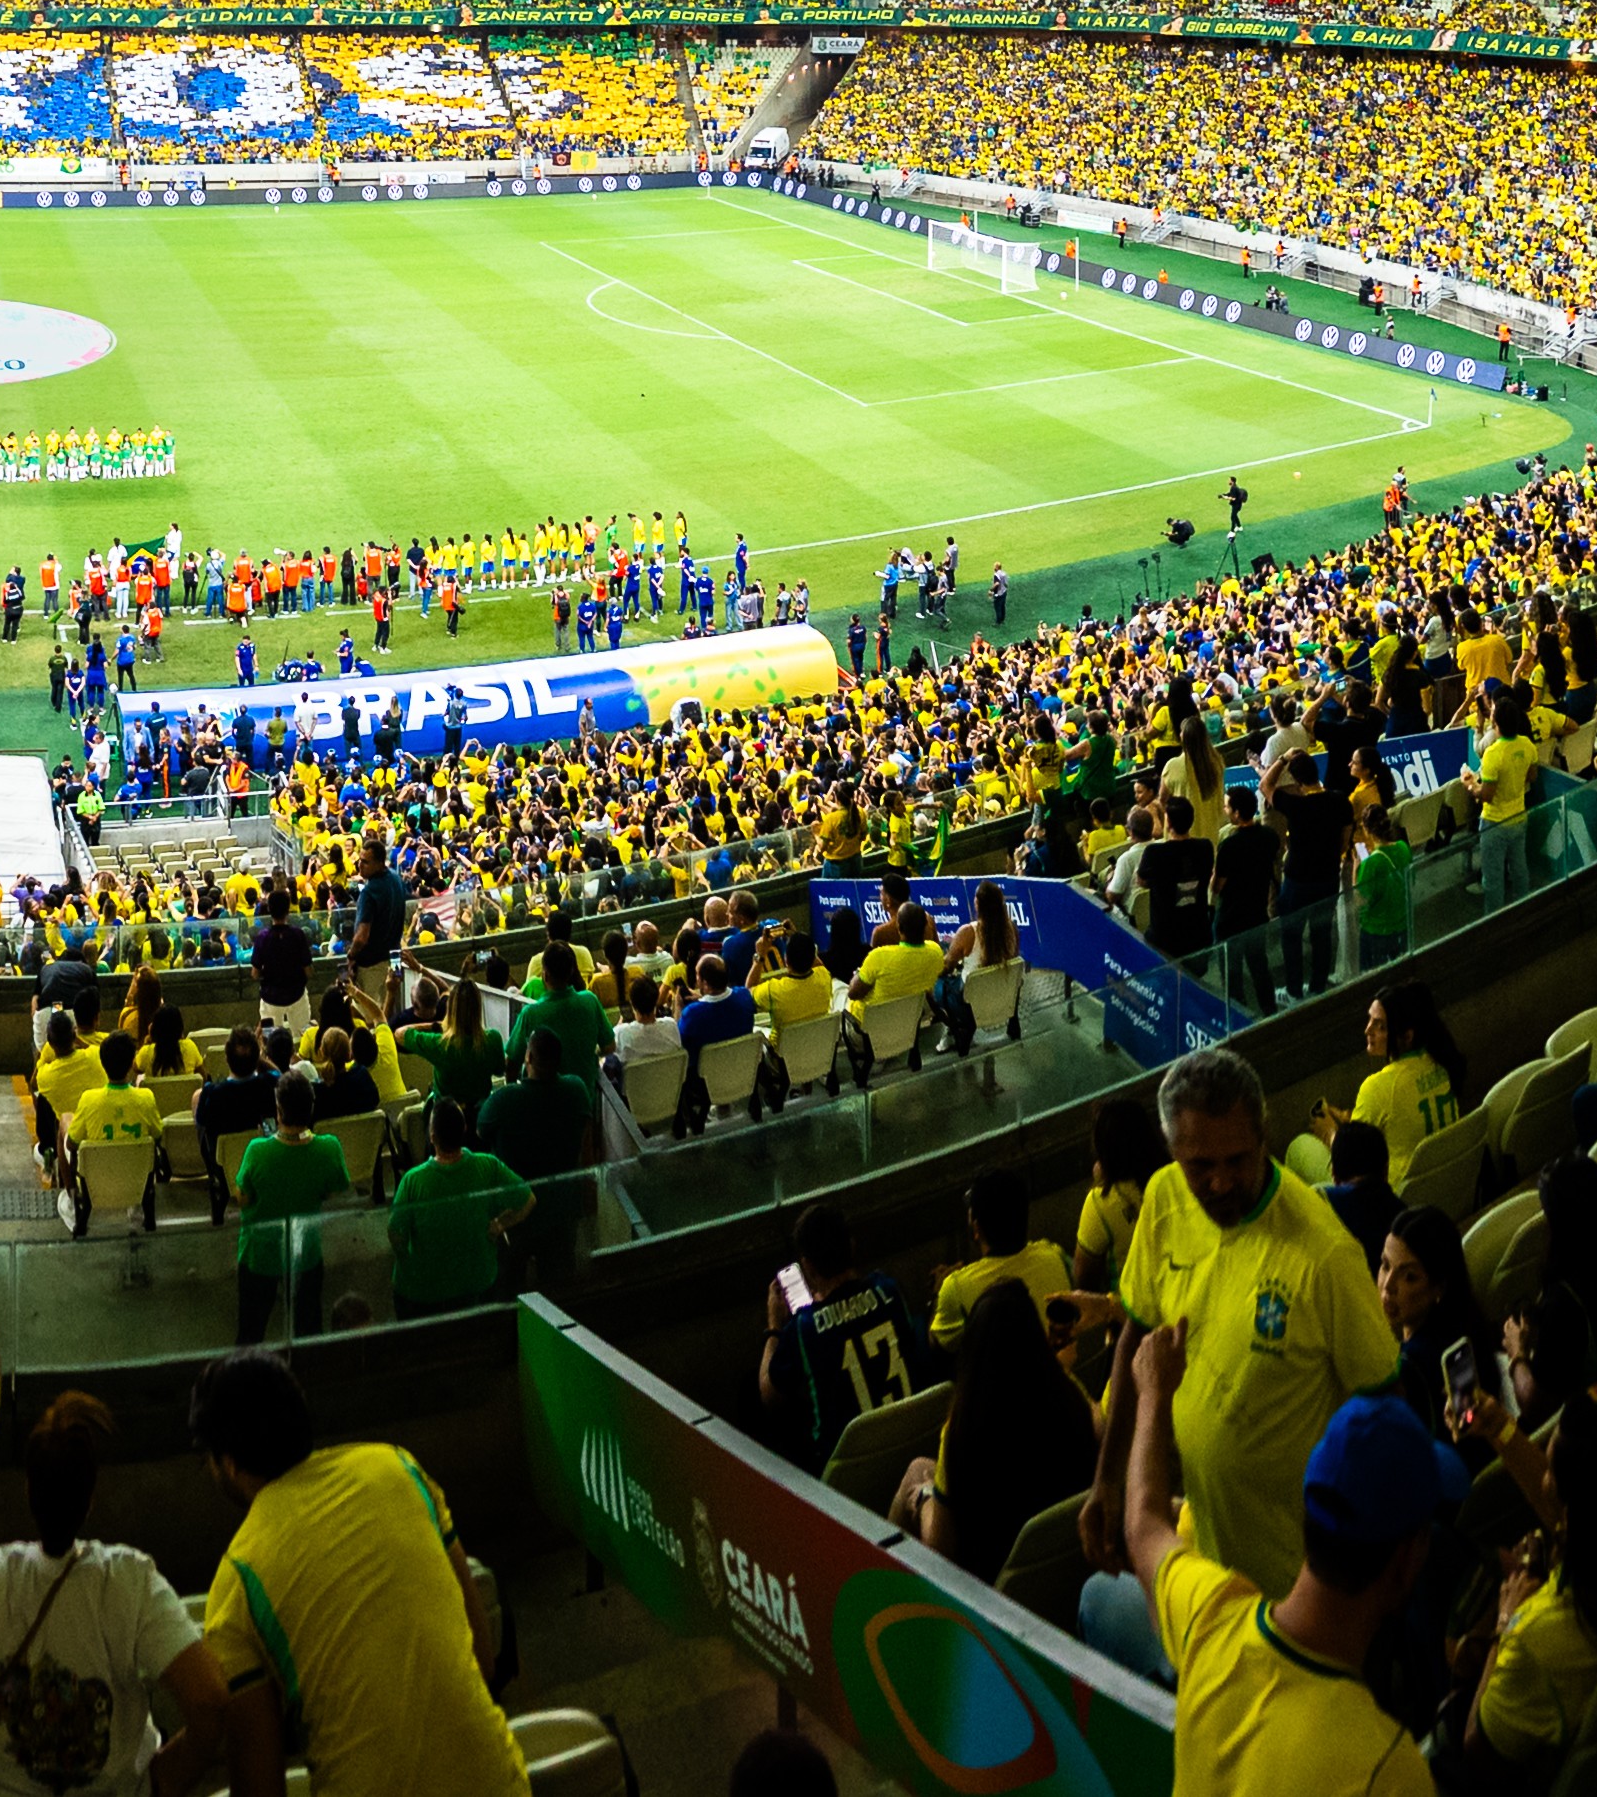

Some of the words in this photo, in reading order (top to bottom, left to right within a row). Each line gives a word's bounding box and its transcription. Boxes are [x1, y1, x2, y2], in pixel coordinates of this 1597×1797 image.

[70, 11, 142, 24] YAYA
[185, 10, 295, 23] LUDMILA
[334, 10, 412, 25] THAÍS
[475, 10, 593, 23] ZANERATTO
[627, 9, 665, 21] ARY
[671, 10, 745, 23] BORGES
[795, 9, 893, 22] PORTILHO
[948, 10, 1040, 25] MARANHÃO
[1077, 15, 1150, 29] MARIZA
[1185, 21, 1211, 34] GIO
[1214, 22, 1288, 37] GARBELINI
[829, 39, 860, 48] CEARÁ
[1322, 28, 1342, 42] R.
[1351, 31, 1414, 46] BAHIA
[1467, 35, 1500, 51] ISA
[1503, 40, 1560, 57] HAAS
[291, 670, 578, 741] BRASIL
[920, 894, 933, 906] Para
[1104, 952, 1122, 977] Para
[1148, 1005, 1161, 1021] do
[812, 1288, 880, 1335] EDUARDO
[874, 1285, 895, 1306] L
[841, 1320, 914, 1413] 13
[722, 1537, 810, 1651] CEARÁ
